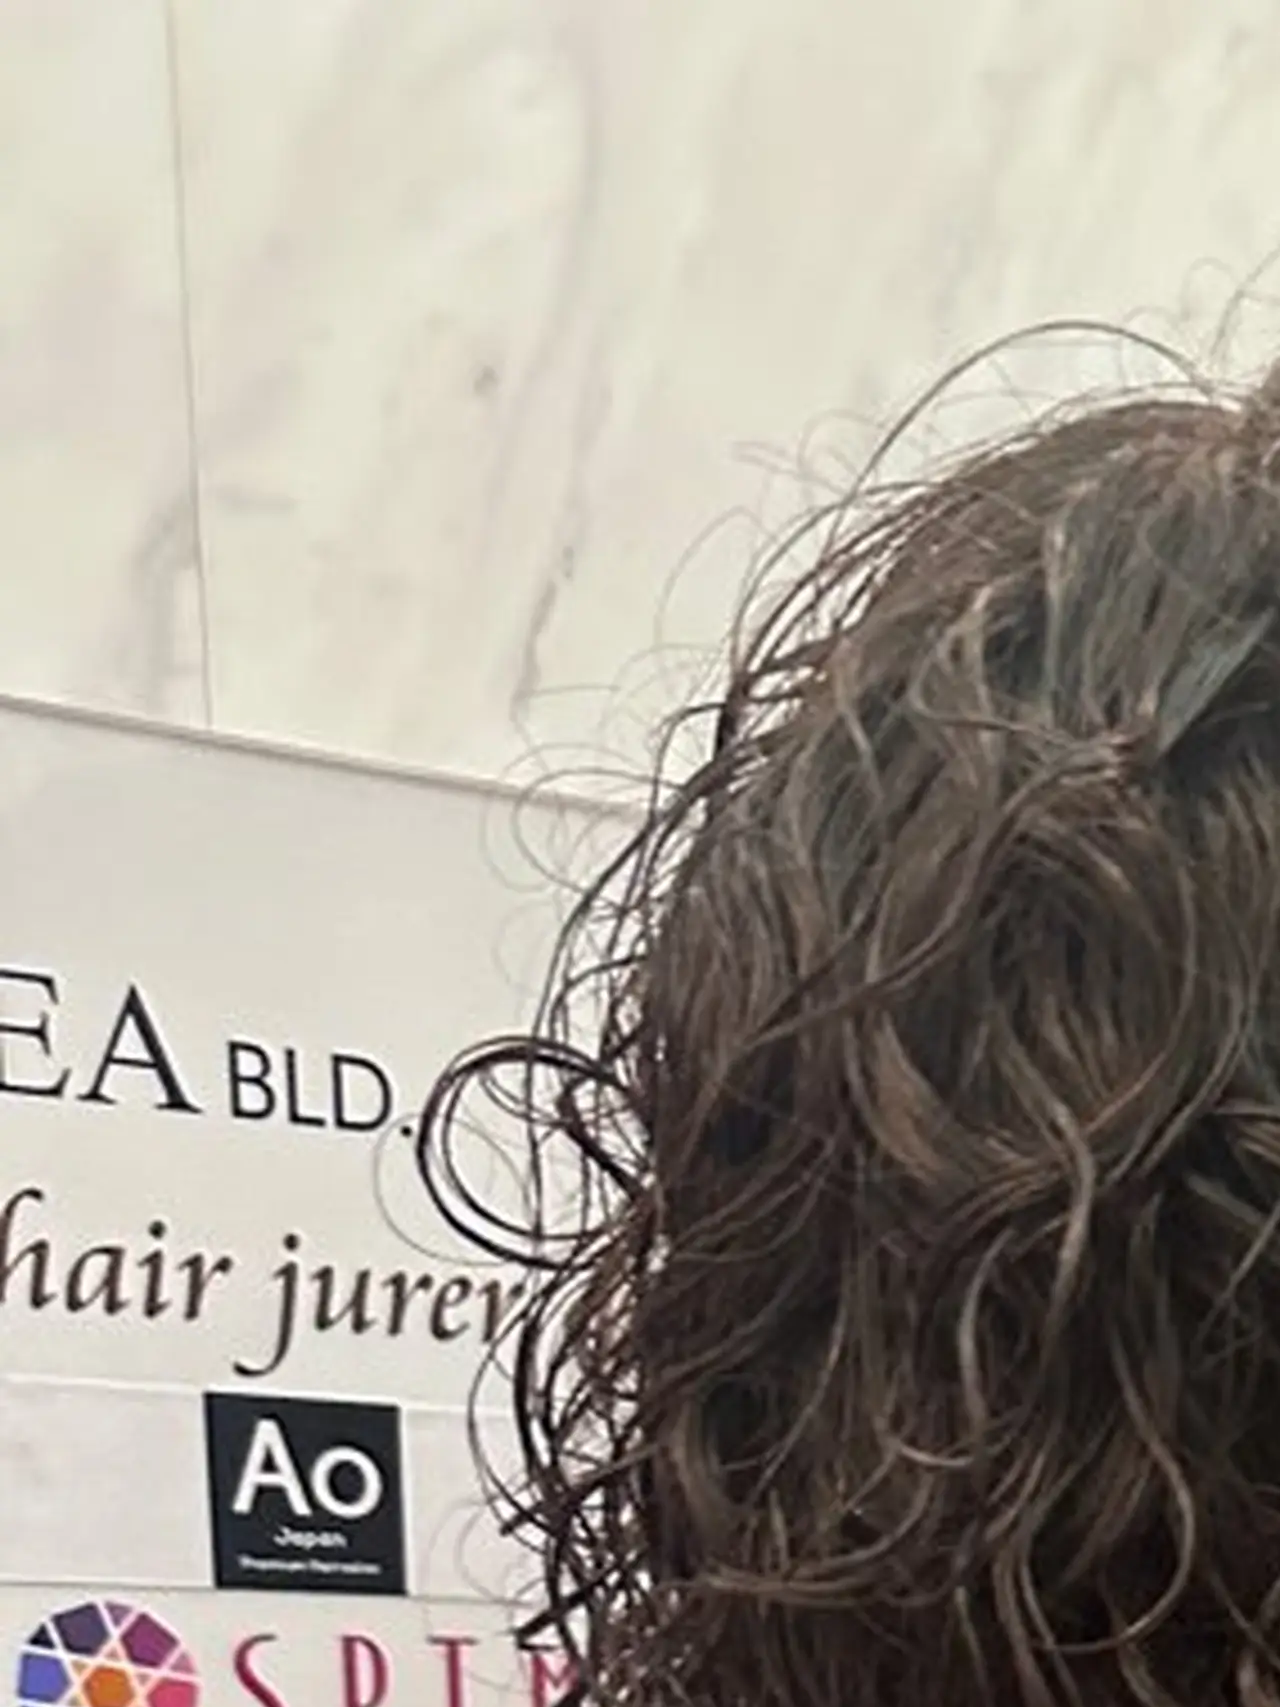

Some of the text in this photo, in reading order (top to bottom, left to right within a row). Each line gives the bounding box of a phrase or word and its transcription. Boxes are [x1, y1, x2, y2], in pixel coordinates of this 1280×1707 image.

[226, 1039, 412, 1137] BLD.
[0, 1187, 525, 1376] hair jurer
[232, 1418, 382, 1519] Ao
